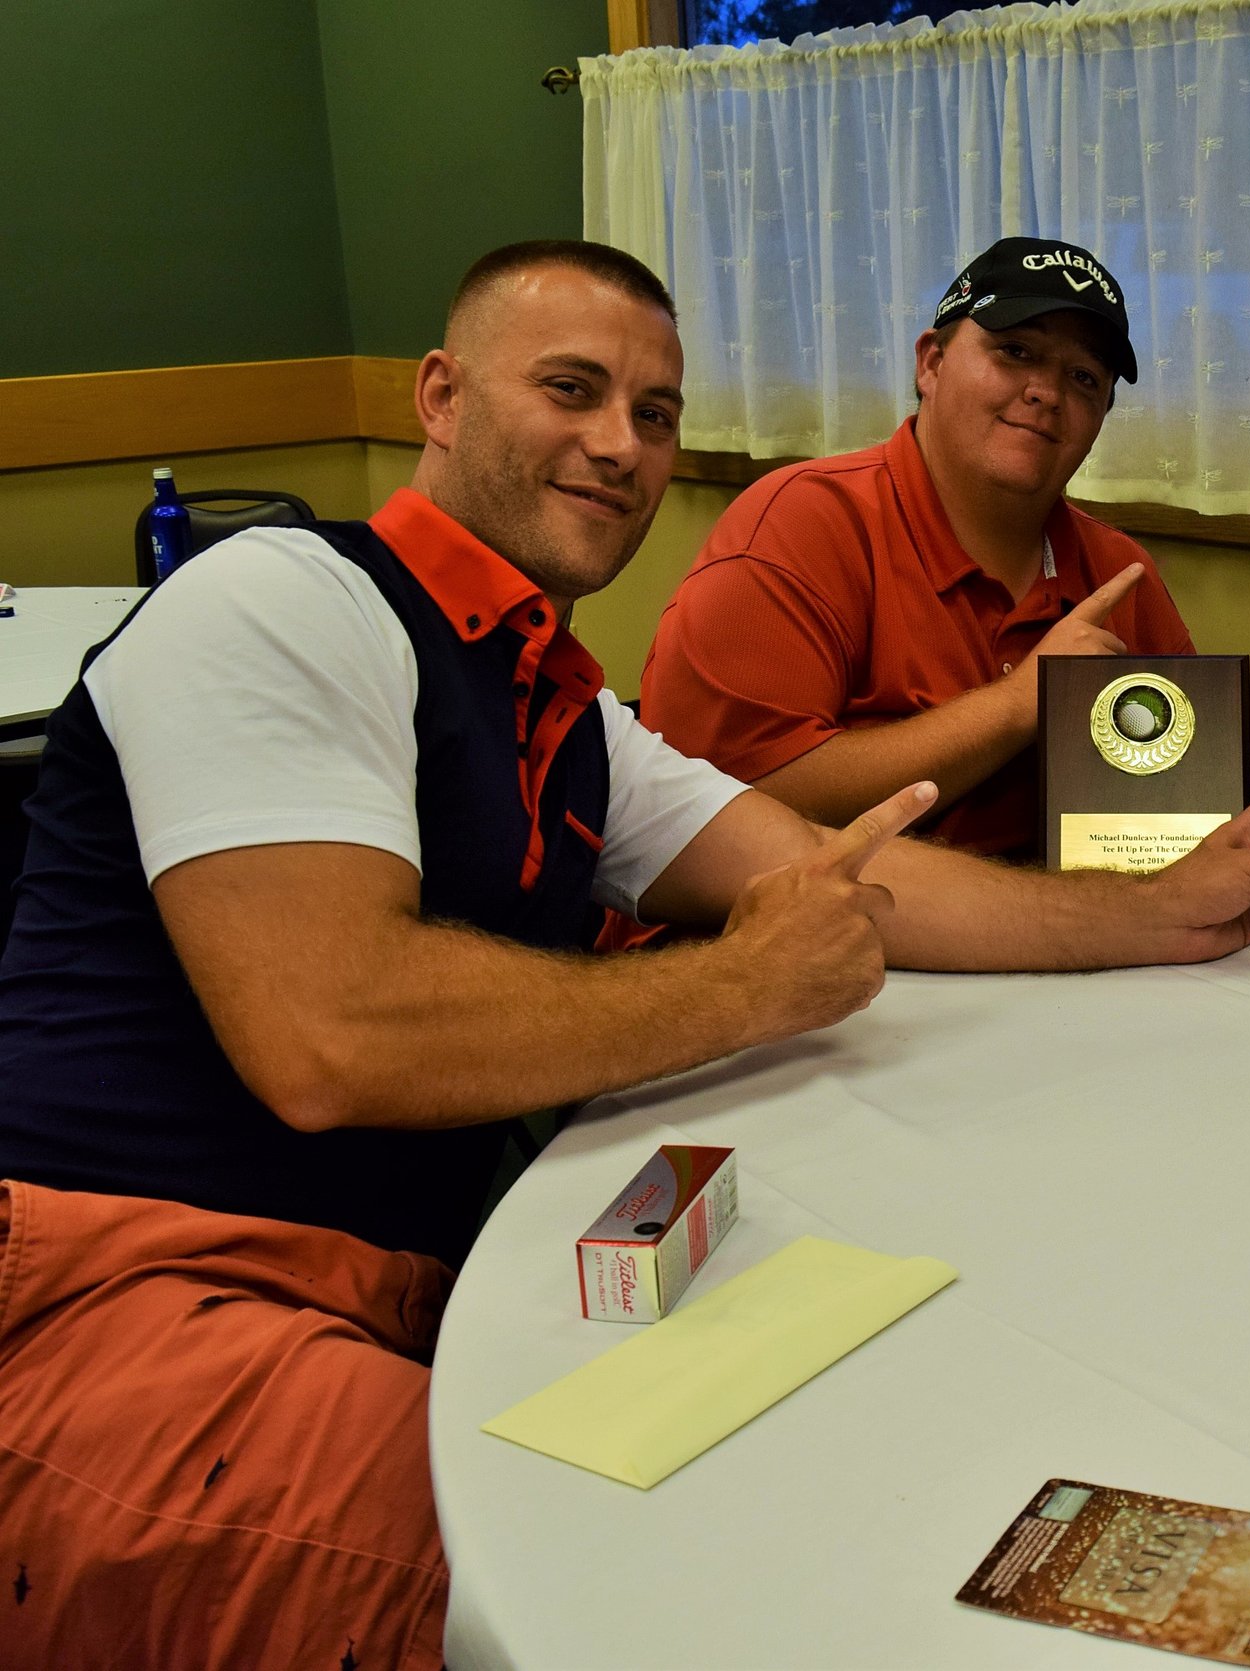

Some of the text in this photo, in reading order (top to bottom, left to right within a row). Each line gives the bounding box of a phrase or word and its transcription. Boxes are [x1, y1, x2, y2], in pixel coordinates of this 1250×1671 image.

[1022, 250, 1118, 304] Callaway
[1089, 833, 1204, 843] Michael Dunleavy Foundation
[1101, 845, 1191, 854] Tee It Up For The Cure
[1127, 857, 1165, 866] Sept 2018
[595, 1252, 603, 1266] DT
[615, 1251, 638, 1315] Titleist
[1115, 1528, 1186, 1595] VISA
